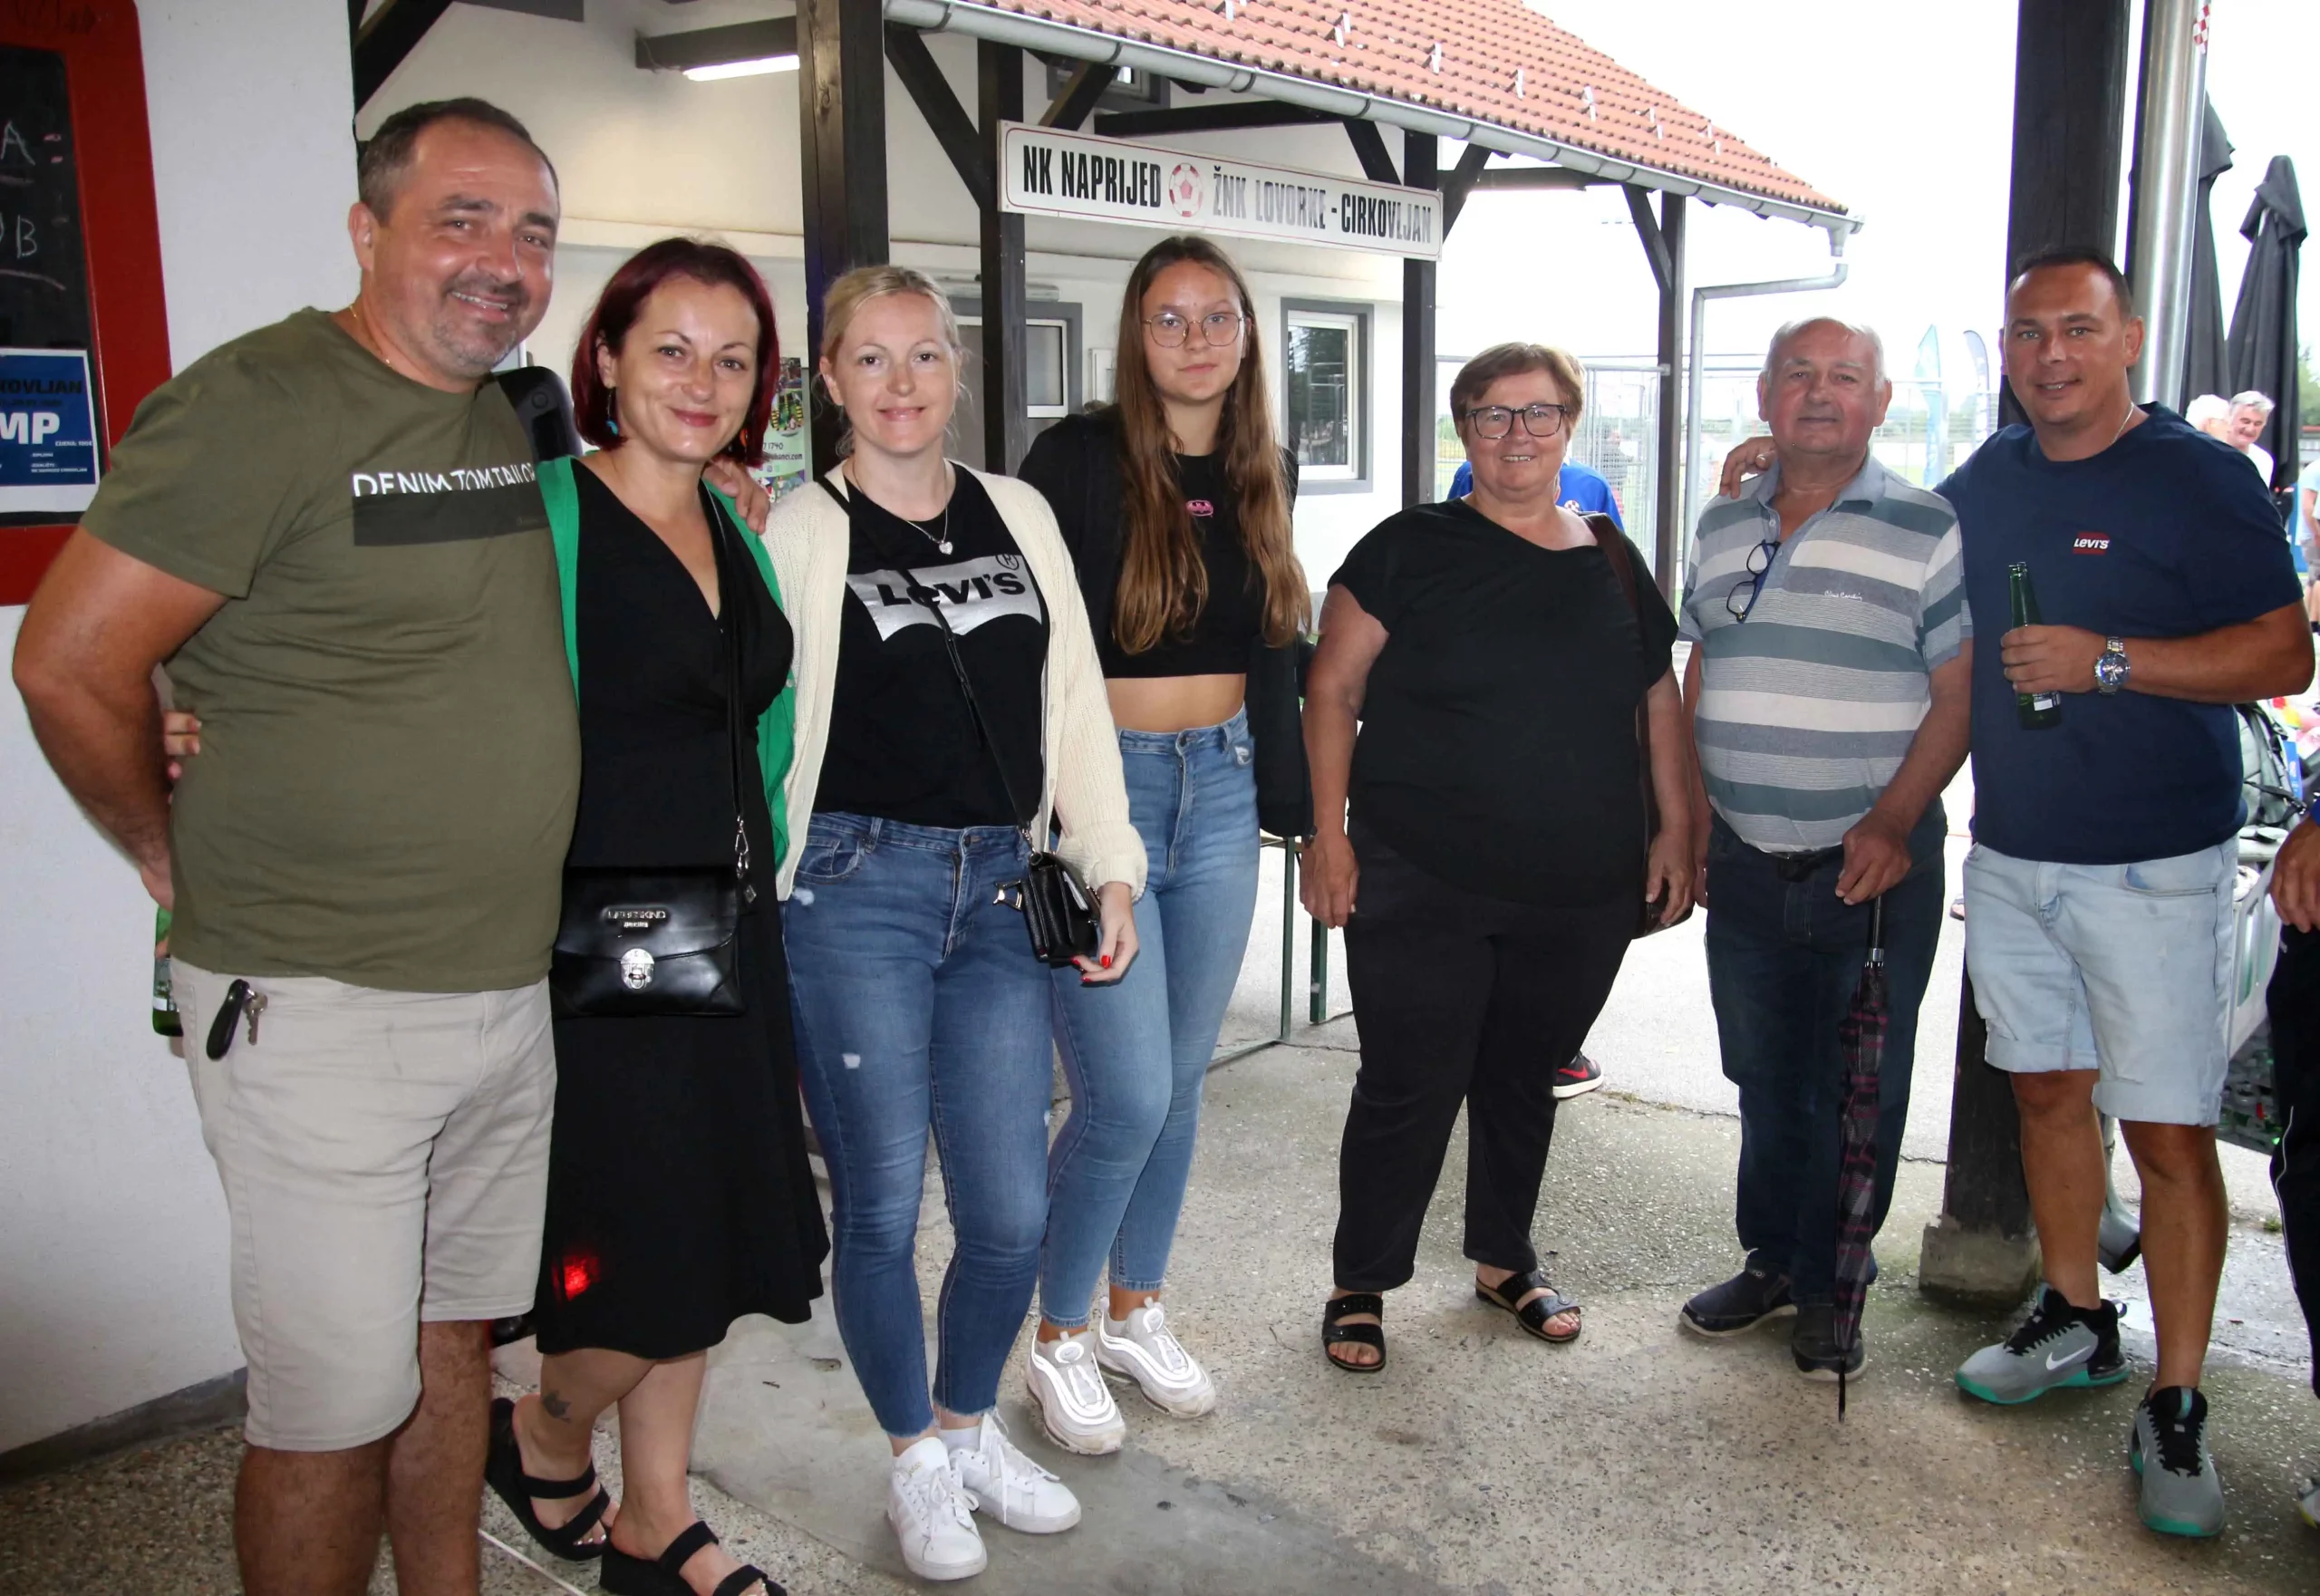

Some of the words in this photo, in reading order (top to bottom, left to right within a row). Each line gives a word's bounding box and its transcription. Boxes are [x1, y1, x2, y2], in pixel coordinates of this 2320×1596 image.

[1023, 145, 1053, 195] NK
[1061, 150, 1161, 208] NAPRIJED
[1213, 165, 1247, 219] ŽNK
[1255, 179, 1326, 229] LOVORKE
[1341, 193, 1431, 244] CIRKOVLJAN
[352, 471, 452, 498] DENIM
